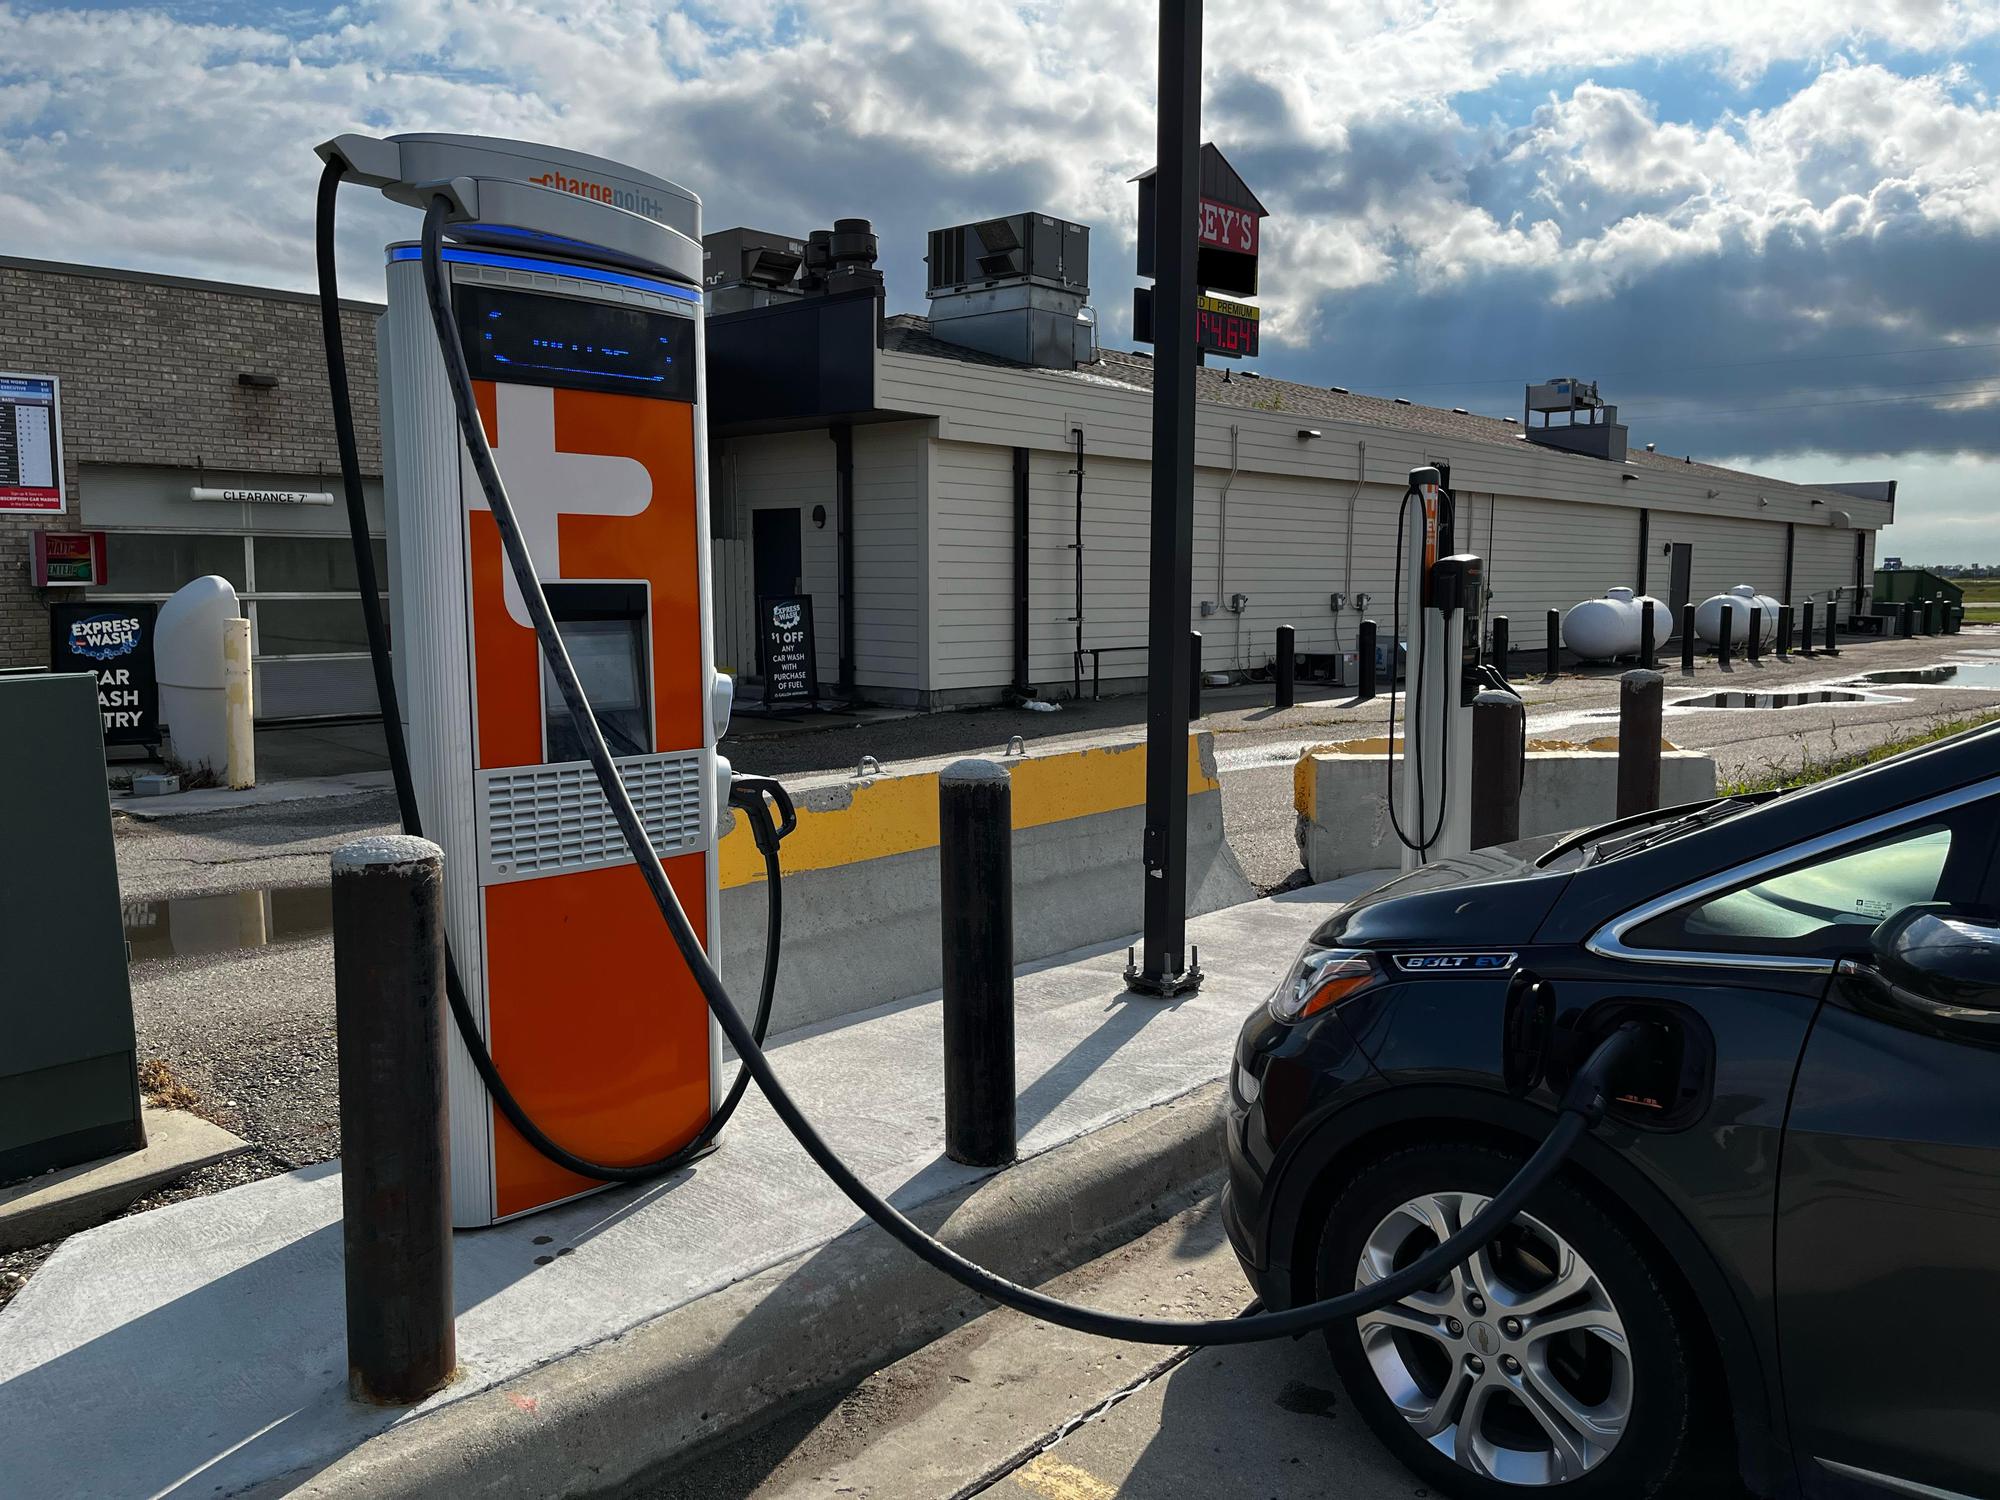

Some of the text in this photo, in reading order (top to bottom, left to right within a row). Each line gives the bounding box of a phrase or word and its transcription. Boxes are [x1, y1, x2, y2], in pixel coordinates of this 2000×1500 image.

[530, 171, 663, 218] chargepoint
[1199, 202, 1252, 250] EY'S
[1217, 301, 1253, 317] PREMIUM
[223, 490, 294, 503] CLEARANCE
[773, 604, 801, 615] EXPRESS
[779, 611, 798, 621] WASH
[71, 618, 140, 636] EXPRESS
[86, 631, 133, 647] WASH
[771, 631, 804, 644] $1 OFF
[781, 645, 795, 653] ANY
[786, 653, 805, 661] WASH
[781, 663, 797, 671] WITH
[774, 671, 807, 681] PURCHASE
[778, 681, 804, 690] OF FUEL
[99, 690, 139, 707] ASH
[104, 711, 143, 728] TRY
[1406, 957, 1507, 967] BOLT EV
